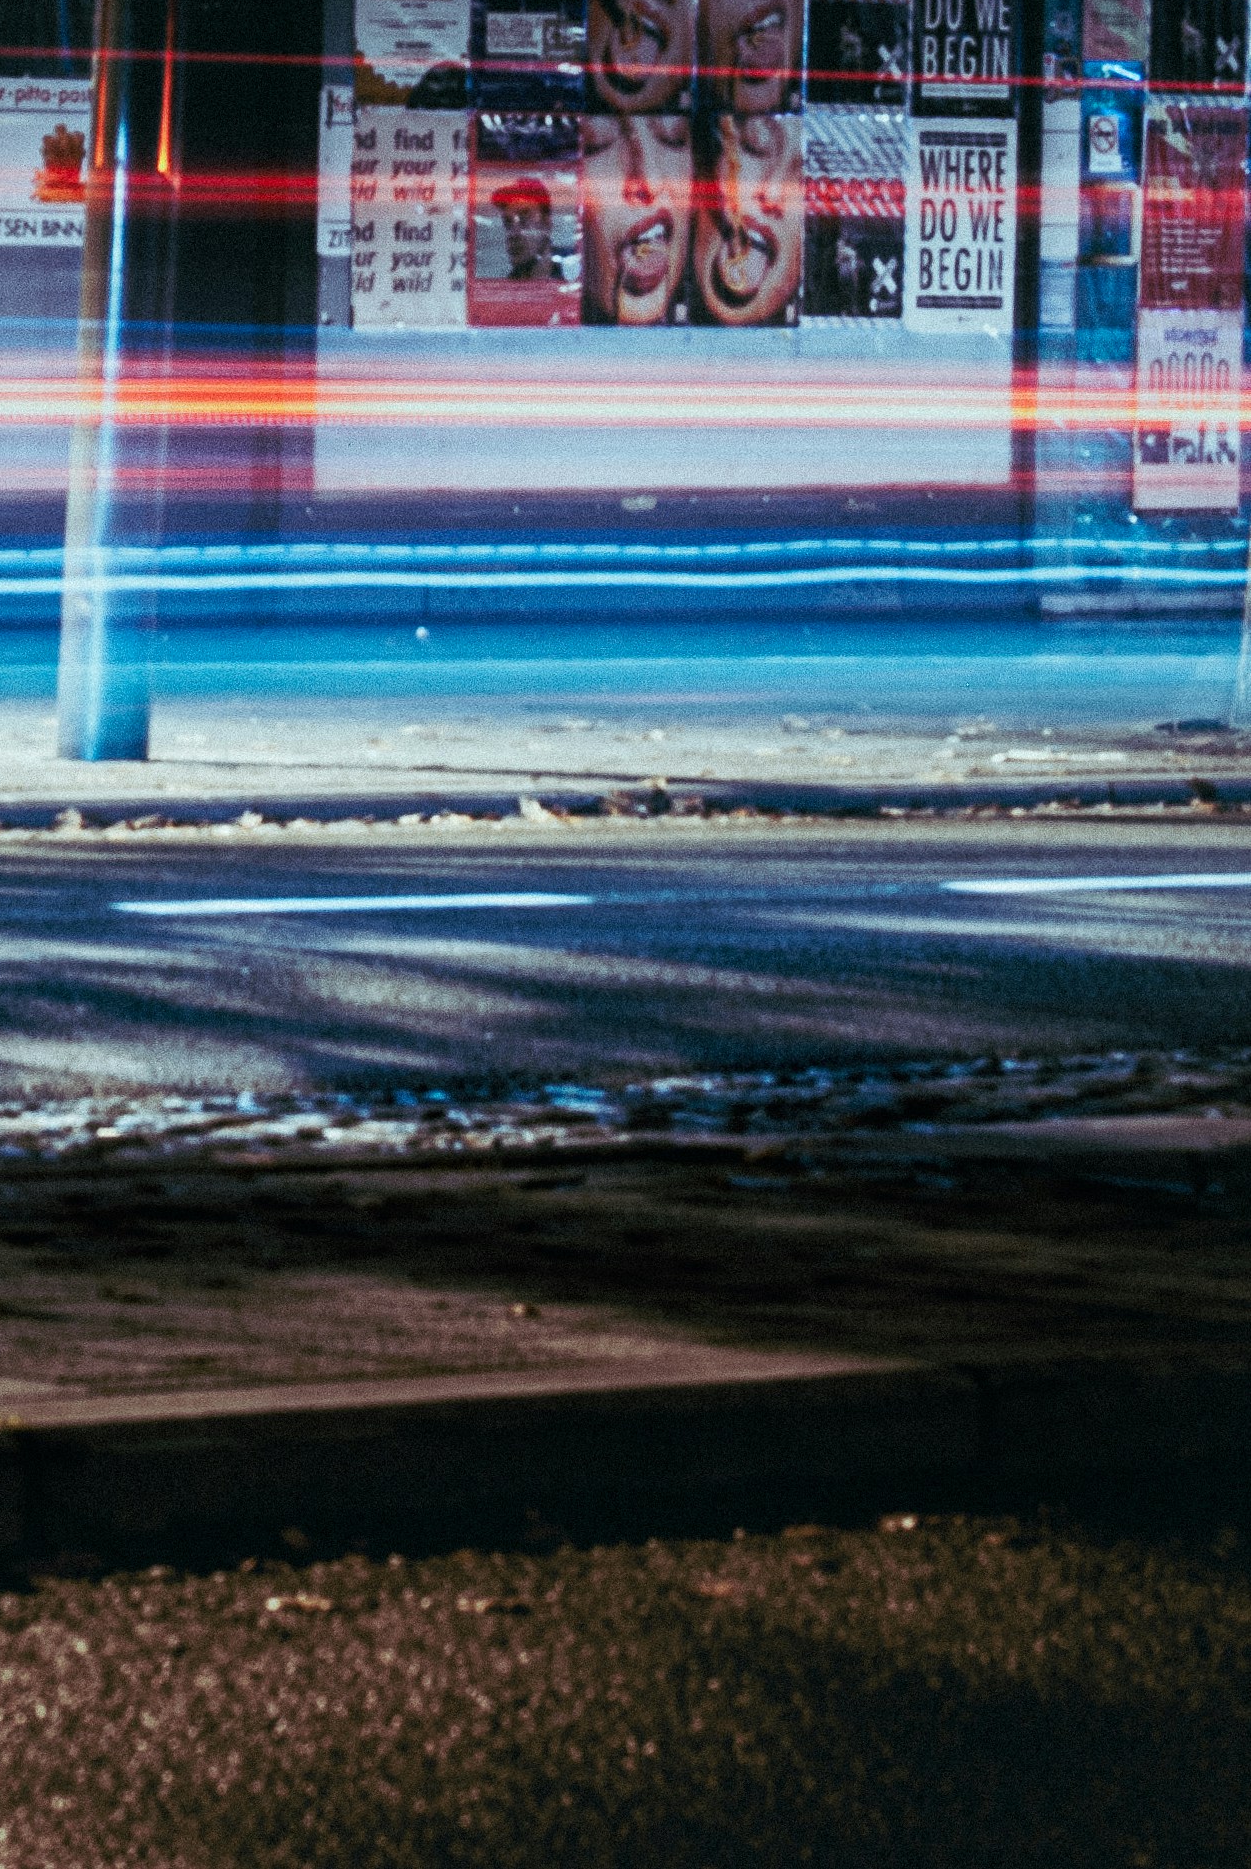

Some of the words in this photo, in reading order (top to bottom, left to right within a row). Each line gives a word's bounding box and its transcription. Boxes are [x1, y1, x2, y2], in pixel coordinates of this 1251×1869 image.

[923, 36, 1009, 80] BEGIN
[394, 128, 434, 150] find
[391, 159, 437, 180] your
[919, 149, 1006, 193] WHERE
[394, 180, 435, 202] wild
[394, 220, 433, 242] find
[920, 198, 957, 242] DO
[969, 199, 1004, 242] WE
[391, 251, 436, 273] your
[919, 247, 1003, 291] BEGIN
[393, 272, 434, 294] wild
